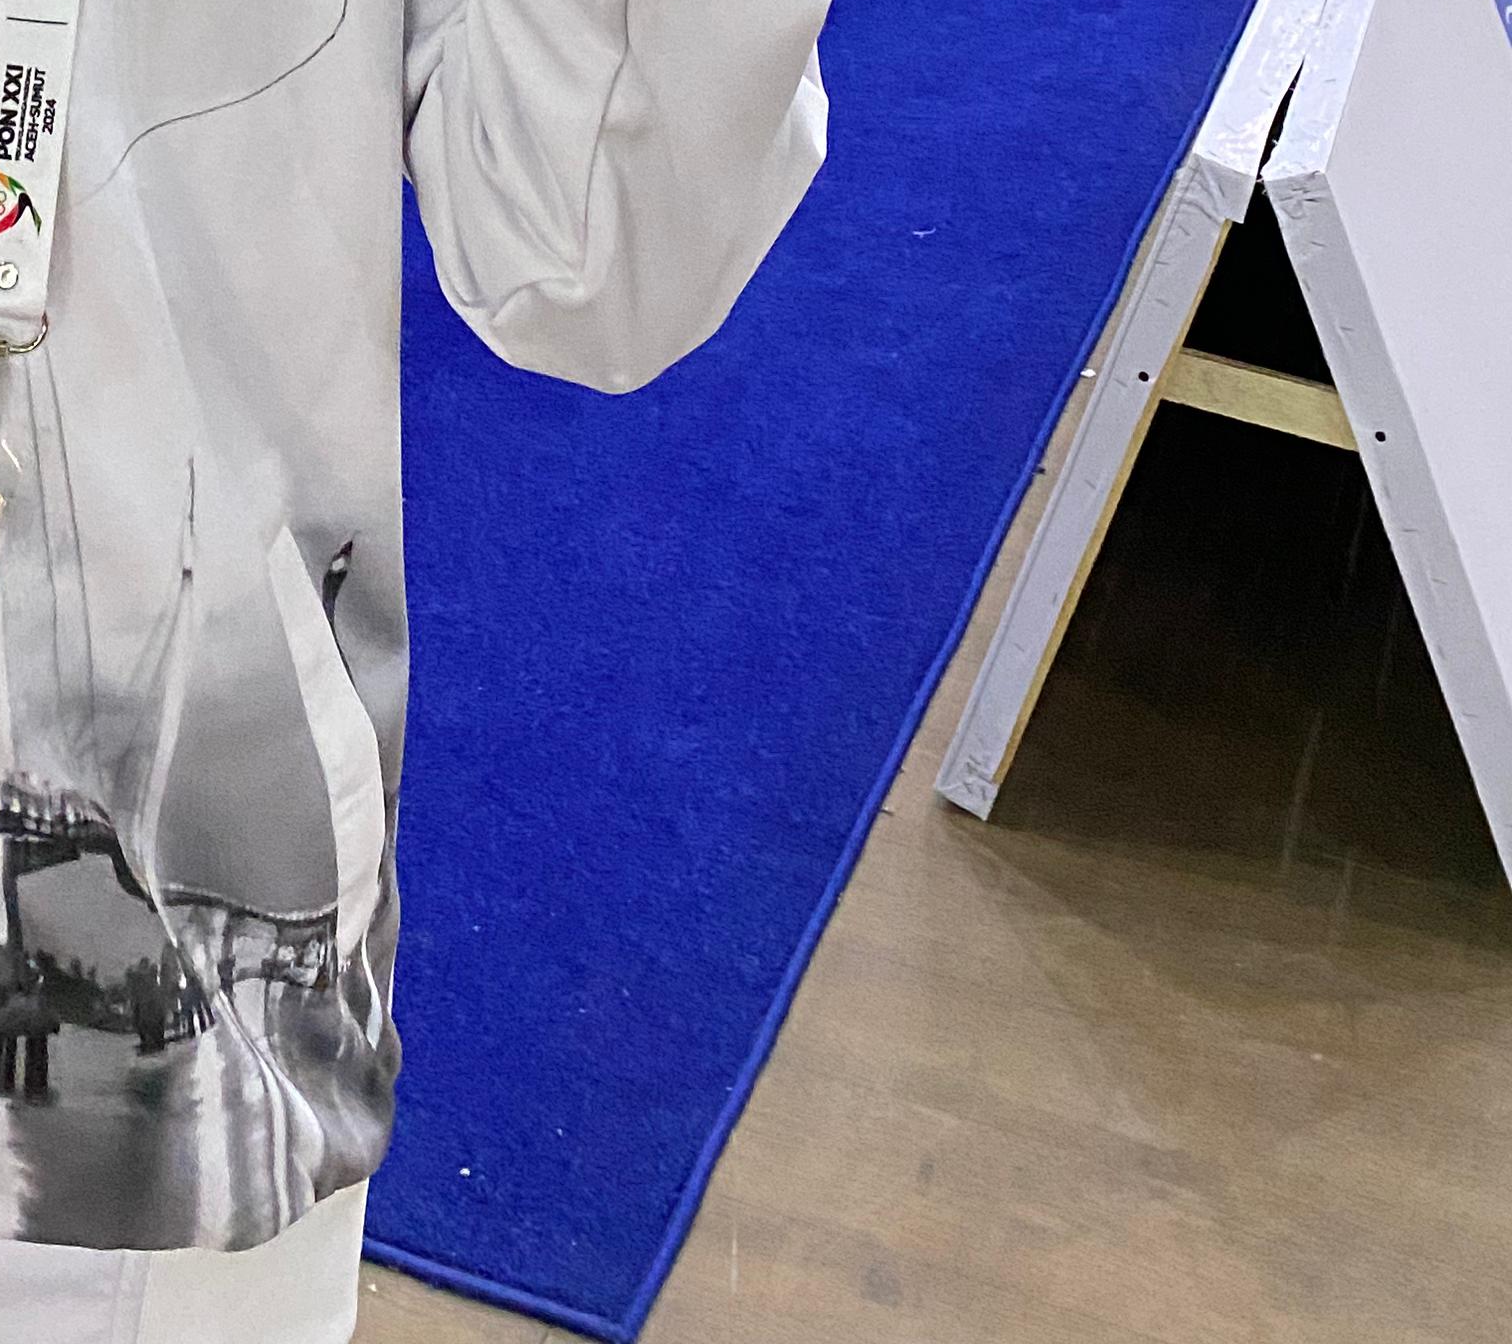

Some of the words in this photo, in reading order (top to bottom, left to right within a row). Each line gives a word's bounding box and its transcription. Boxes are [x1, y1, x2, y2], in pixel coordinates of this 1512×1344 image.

[2, 64, 23, 105] XXI
[24, 67, 46, 162] ACEH-SUMUT
[42, 99, 57, 135] 2024
